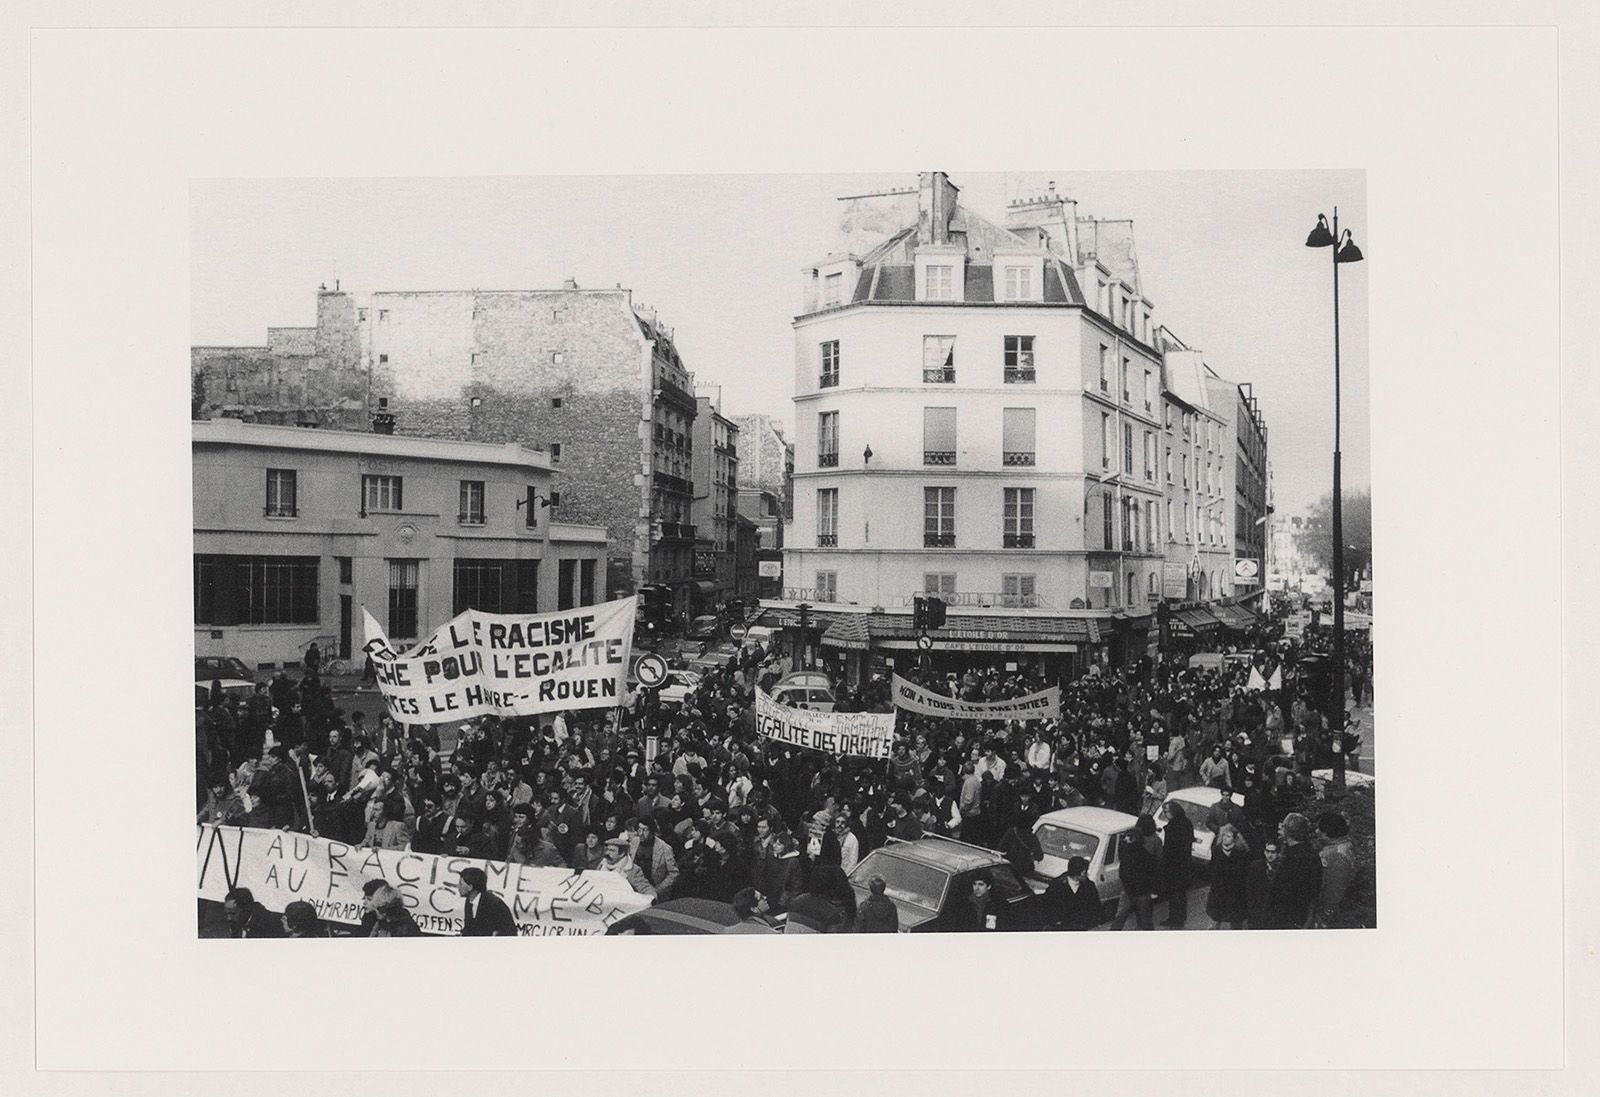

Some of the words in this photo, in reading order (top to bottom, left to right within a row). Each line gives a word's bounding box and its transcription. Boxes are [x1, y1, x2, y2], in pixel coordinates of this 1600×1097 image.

[450, 621, 483, 649] LE
[490, 615, 595, 649] RACISME
[493, 638, 622, 678] L'EGALITE
[429, 692, 459, 712] LE
[539, 677, 616, 702] ROUEN
[927, 698, 955, 710] TOUS
[757, 713, 809, 746] EGALITE
[813, 730, 837, 752] DES
[840, 734, 891, 757] DROITS
[265, 864, 308, 893] AU
[267, 835, 310, 861] AU
[328, 841, 541, 893] RACISME
[558, 874, 626, 928] AUBE
